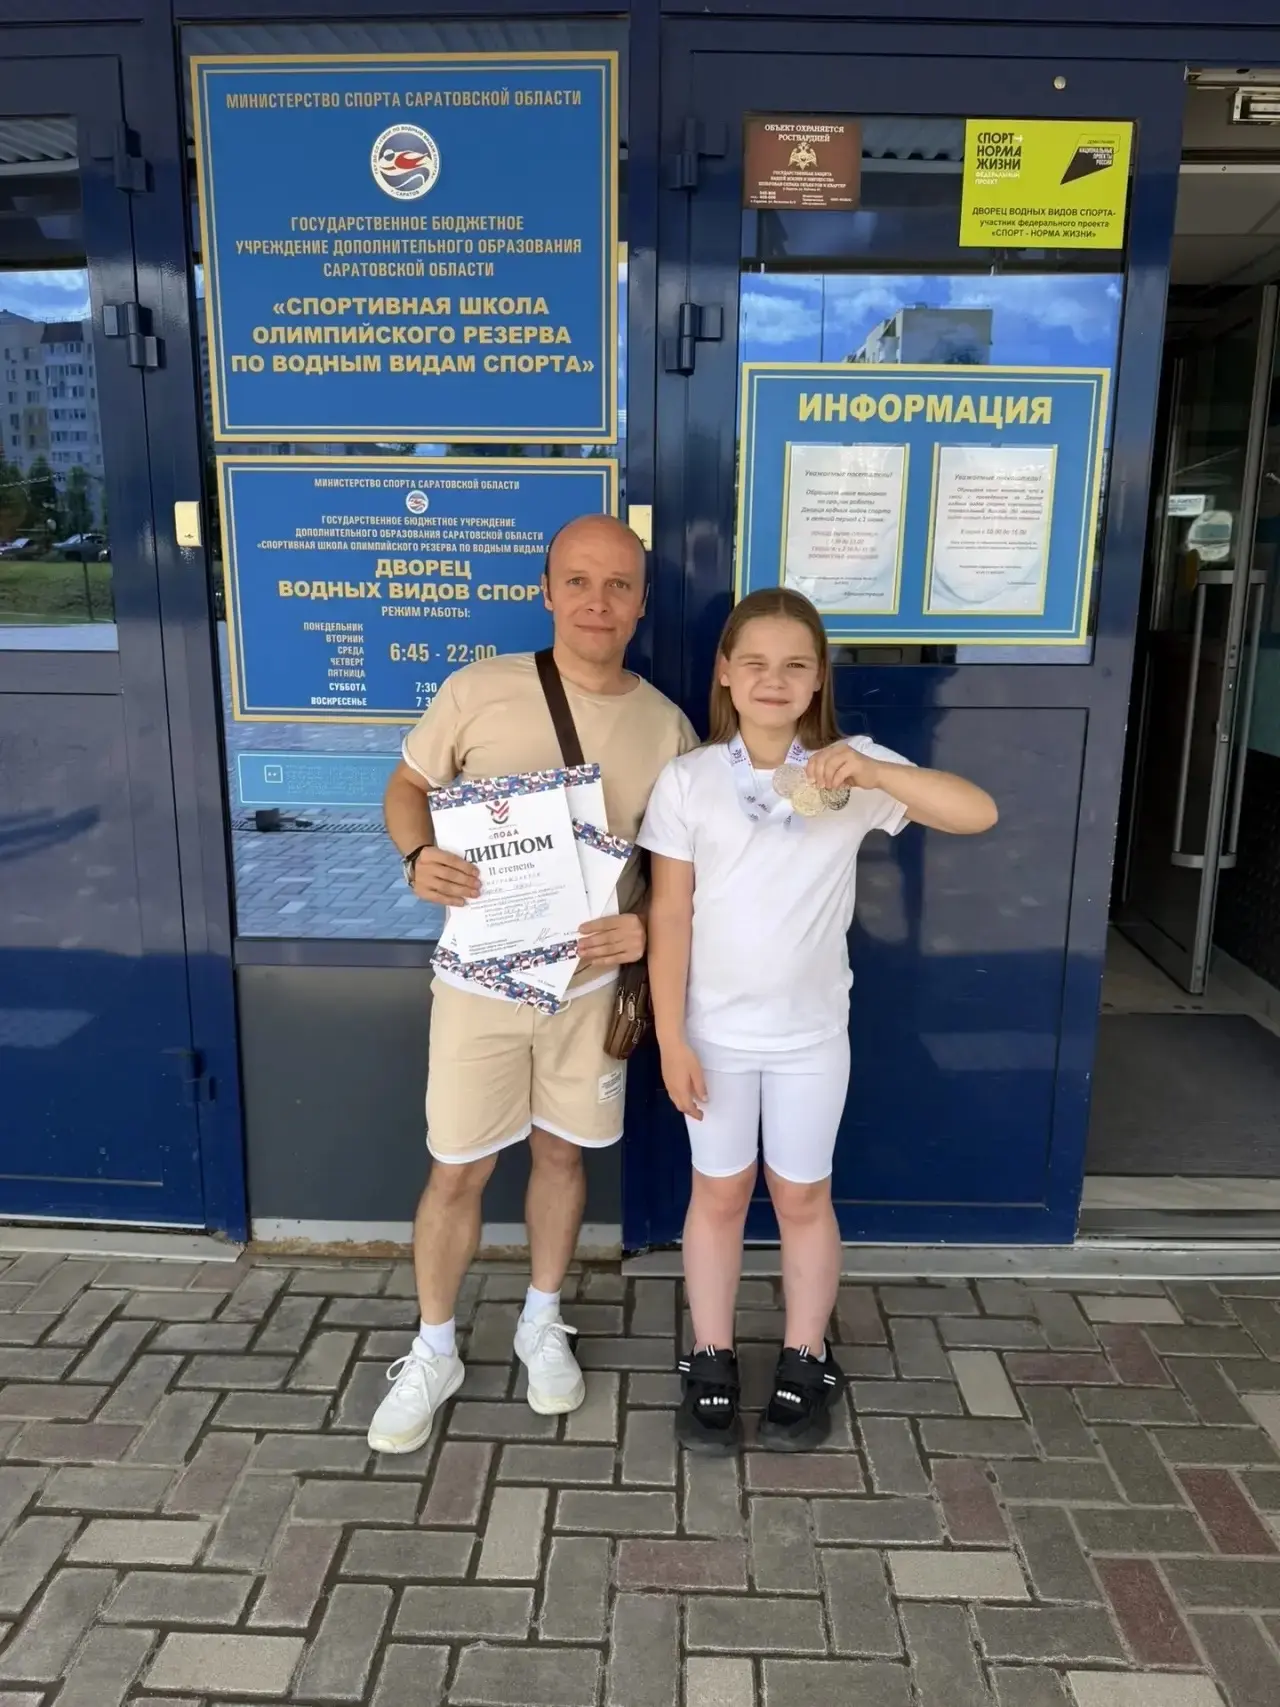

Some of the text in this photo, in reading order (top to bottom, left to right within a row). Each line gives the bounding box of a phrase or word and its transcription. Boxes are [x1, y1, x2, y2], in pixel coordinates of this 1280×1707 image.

[226, 87, 582, 109] МИНИСТЕРСТВО СПОРТА САРАТОВСКОЙ ОБЛАСТИ
[764, 124, 845, 133] ОБЪЕКТ ОХРАНЯЕТСЯ
[778, 133, 831, 143] РОСГВАРДИЕЙ
[977, 132, 1015, 144] СПОРТ
[976, 145, 1022, 157] НОРМА
[976, 158, 1021, 170] ЖИЗНИ
[972, 207, 1007, 216] ДВОРЕЦ
[1009, 207, 1045, 217] ВОДНЫХ
[1048, 208, 1077, 217] ВИДОВ
[291, 215, 524, 233] ГОСУДАРСТВЕННОЕ БЮДЖЕТНОЕ
[980, 219, 1110, 229] участник федерального проекта
[992, 229, 1024, 237] «СПОРТ
[1031, 229, 1061, 237] НОРМА
[1062, 229, 1096, 238] ЖИЗНИ»
[236, 238, 582, 256] УЧРЕЖДЕНИЕ ДОПОЛНИТЕЛЬНОГО ОБРАЗОВАНИЯ
[323, 259, 494, 277] САРАТОВСКОЙ ОБЛАСТИ
[273, 297, 550, 316] «СПОРТИВНАЯ ШКОЛА
[252, 323, 572, 345] ОЛИМПИЙСКОГО РЕЗЕРВА
[231, 355, 595, 376] ПО ВОДНЫМ ВИДАМ СПОРТА»
[799, 393, 1053, 430] ИНФОРМАЦИЯ
[314, 478, 520, 490] МИНИСТЕРСТВО СПОРТА САРАТОВСКОЙ ОБЛАСТИ
[321, 515, 516, 528] ГОСУДАРСТВЕННОЕ БЮДЖЕТНОЕ УЧРЕЖДЕНИЕ
[295, 528, 544, 541] ДОПОЛНИТЕЛЬНОГО ОБРАЗОВАНИЯ САРАТОВСКОЙ ОБЛАСТИ
[256, 540, 316, 550] «СПОРТИВНАЯ
[317, 541, 348, 551] ШКОЛА
[350, 540, 419, 552] ОЛИМПИЙСКОГО
[420, 543, 458, 553] РЕЗЕРВА
[460, 543, 471, 553] ПО
[472, 544, 512, 554] ВОДНЫМ
[514, 544, 544, 555] ВИДАМ
[375, 559, 472, 580] ДВОРЕЦ
[278, 580, 544, 603] ВОДНЫХ ВИДОВ СПОР
[381, 606, 471, 618] РЕЖИМ РАБОТЫ:
[303, 622, 364, 632] ПОНЕДЕЛЬНИК
[326, 634, 364, 644] ВТОРНИК
[337, 646, 365, 656] СРЕДА
[389, 642, 430, 662] 6:45
[446, 644, 497, 663] 22:00
[331, 657, 365, 667] ЧЕТВЕРГ
[327, 668, 366, 678] ПЯТНИЦА
[329, 681, 437, 693] СУББОТА 7:30
[311, 697, 368, 706] ВОСКРЕСЕНЬЕ
[464, 834, 554, 864] ДИПЛОМ
[498, 862, 536, 874] степень
